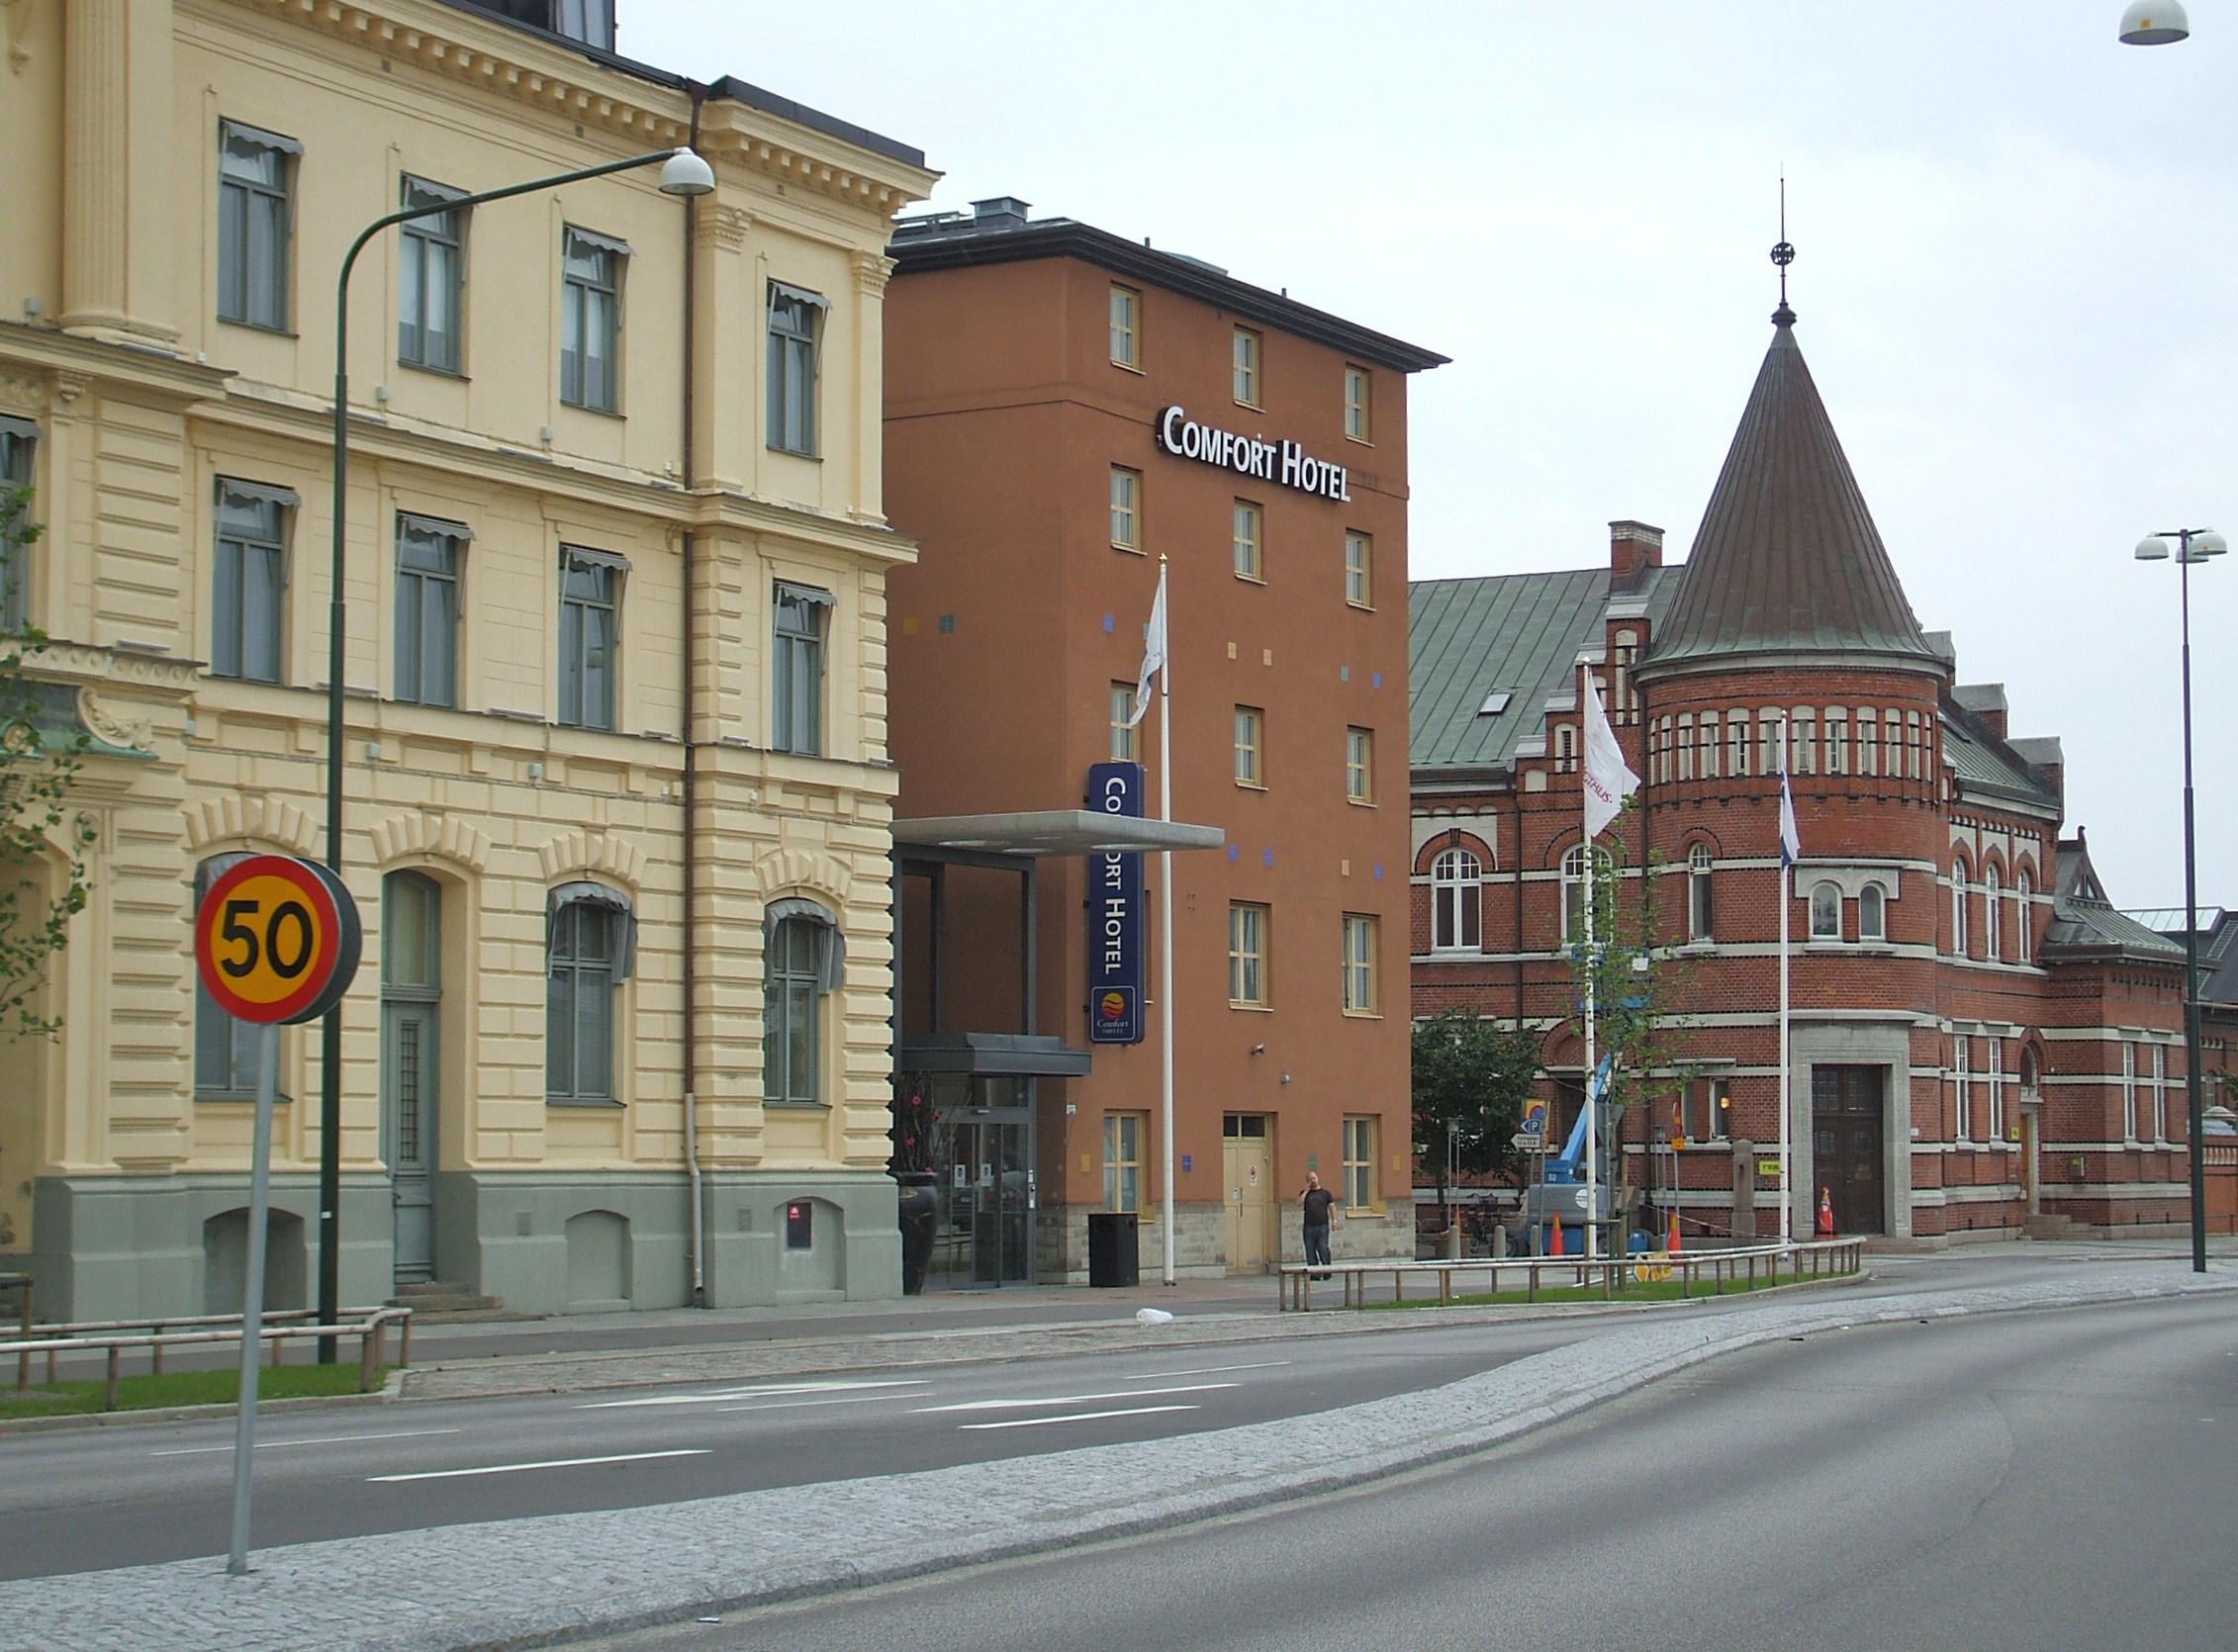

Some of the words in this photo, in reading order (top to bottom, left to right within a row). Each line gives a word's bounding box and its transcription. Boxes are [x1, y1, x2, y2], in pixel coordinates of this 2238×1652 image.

[1163, 406, 1276, 480] COMFORT
[1281, 439, 1352, 502] HOTEL
[1105, 777, 1126, 890] COORT
[221, 899, 314, 979] 50
[1105, 897, 1126, 974] HOTEL
[1096, 1019, 1129, 1028] Comfort
